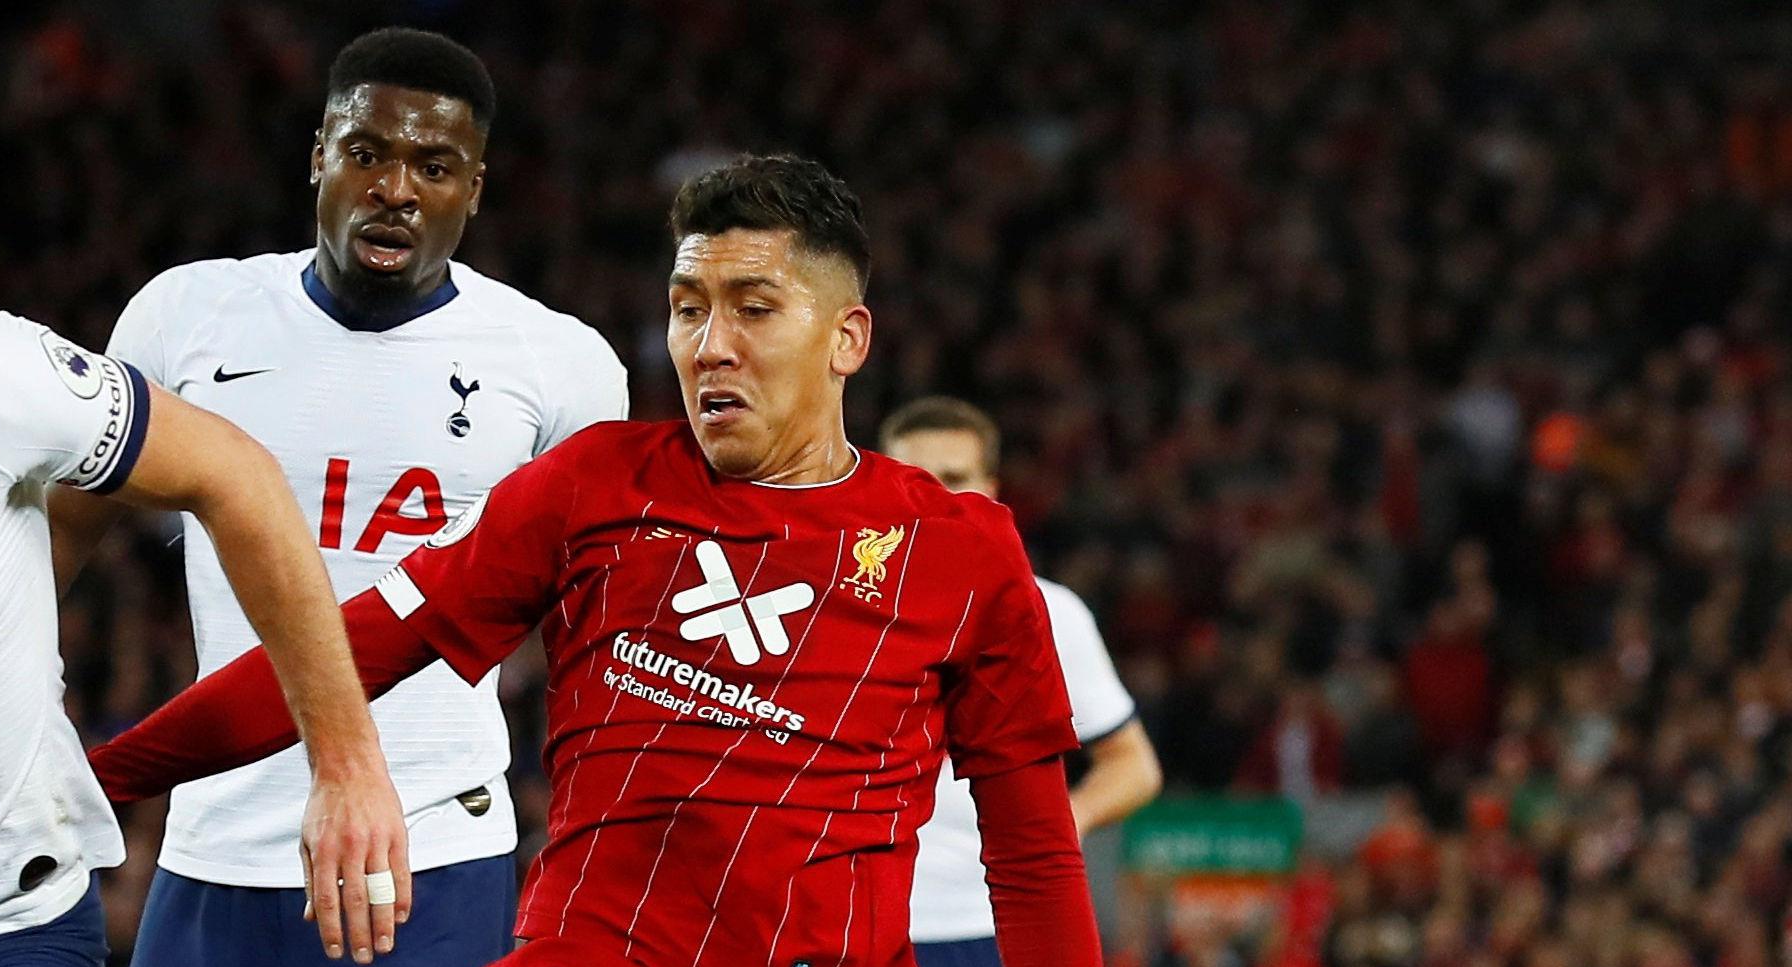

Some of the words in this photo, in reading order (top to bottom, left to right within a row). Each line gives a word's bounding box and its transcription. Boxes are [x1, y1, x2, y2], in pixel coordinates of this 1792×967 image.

[79, 361, 122, 476] Captain
[319, 457, 448, 554] IA
[603, 666, 619, 691] by
[617, 672, 697, 716] Standard
[612, 631, 805, 732] futuremakers
